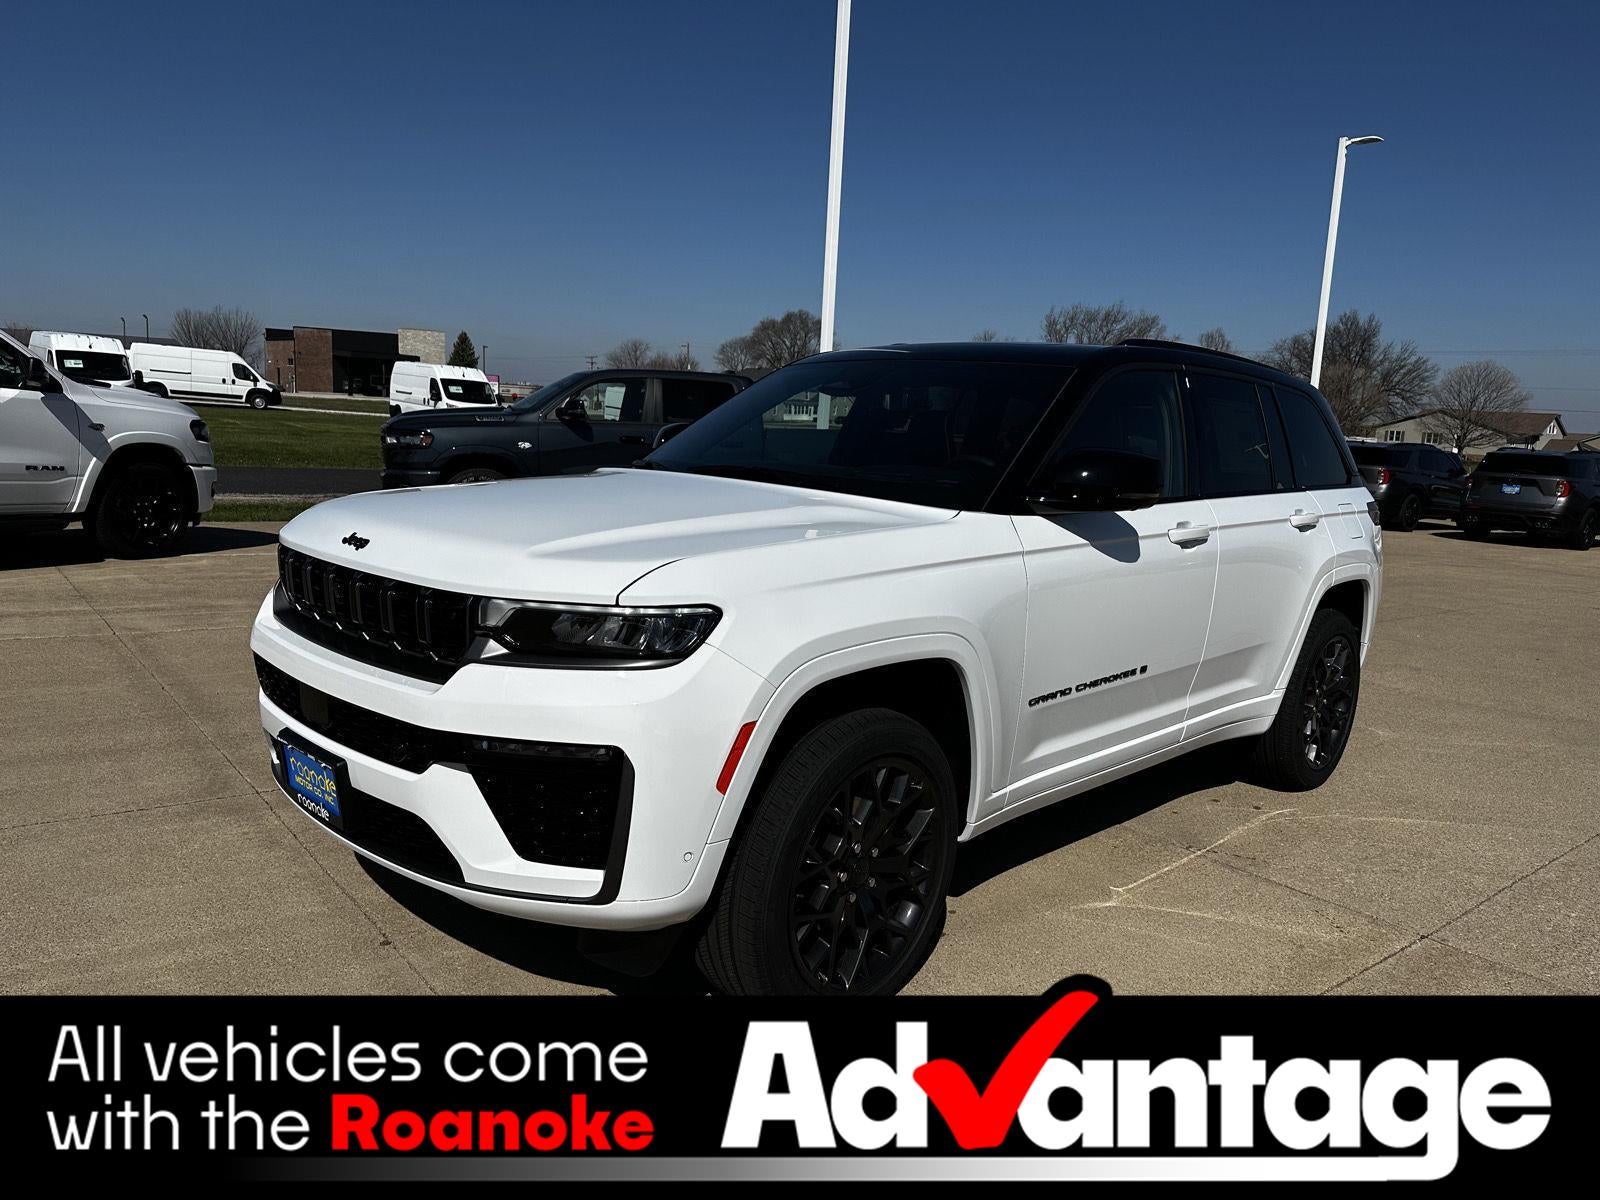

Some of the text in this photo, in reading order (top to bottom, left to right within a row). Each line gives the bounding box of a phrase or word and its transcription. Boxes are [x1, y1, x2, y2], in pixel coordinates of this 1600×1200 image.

[1028, 667, 1138, 708] GRAND CHEROKEE
[290, 756, 337, 797] roanoke
[294, 774, 313, 792] MOTOR
[297, 793, 330, 821] roanoke
